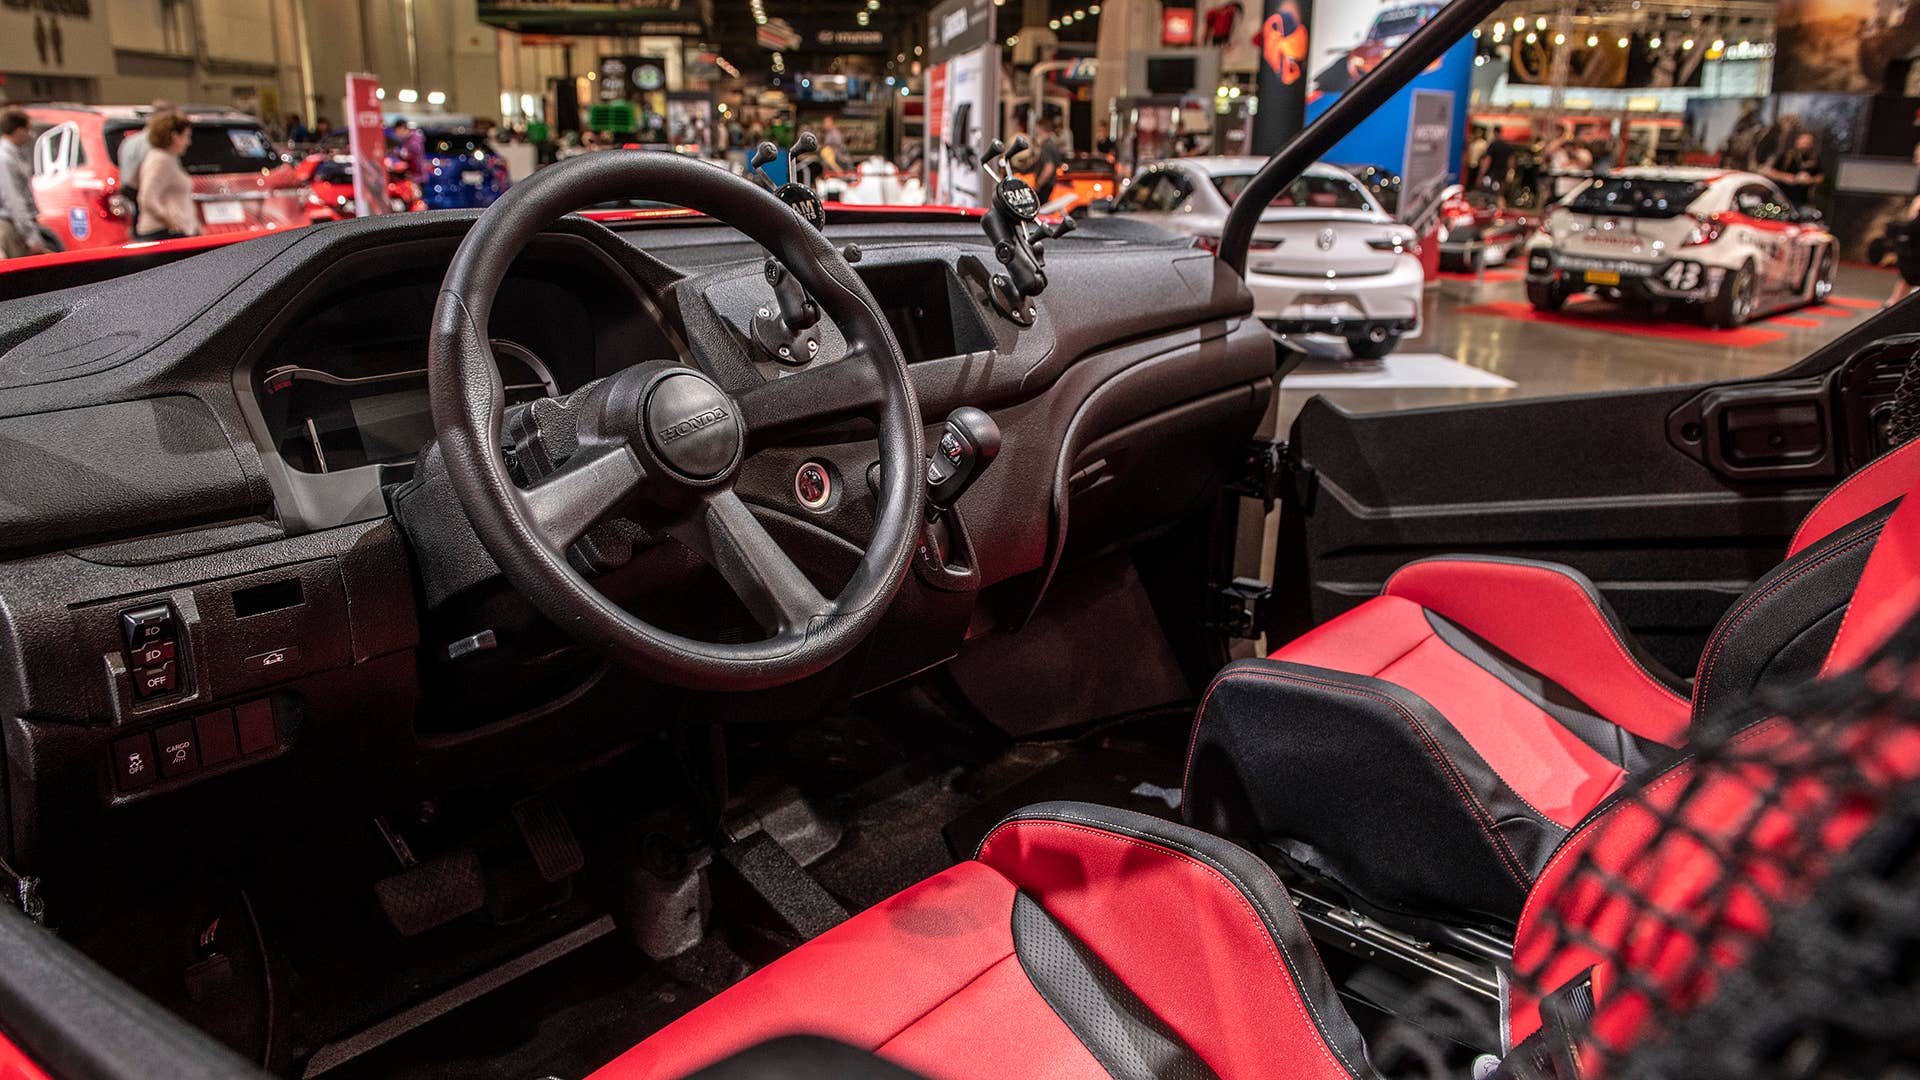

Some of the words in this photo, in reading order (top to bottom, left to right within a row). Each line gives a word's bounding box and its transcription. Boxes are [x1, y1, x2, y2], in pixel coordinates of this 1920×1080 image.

[1664, 260, 1701, 290] 43
[659, 407, 729, 445] HONDA
[147, 675, 167, 688] OFF
[166, 741, 190, 754] CARGO
[128, 764, 145, 775] OFF
